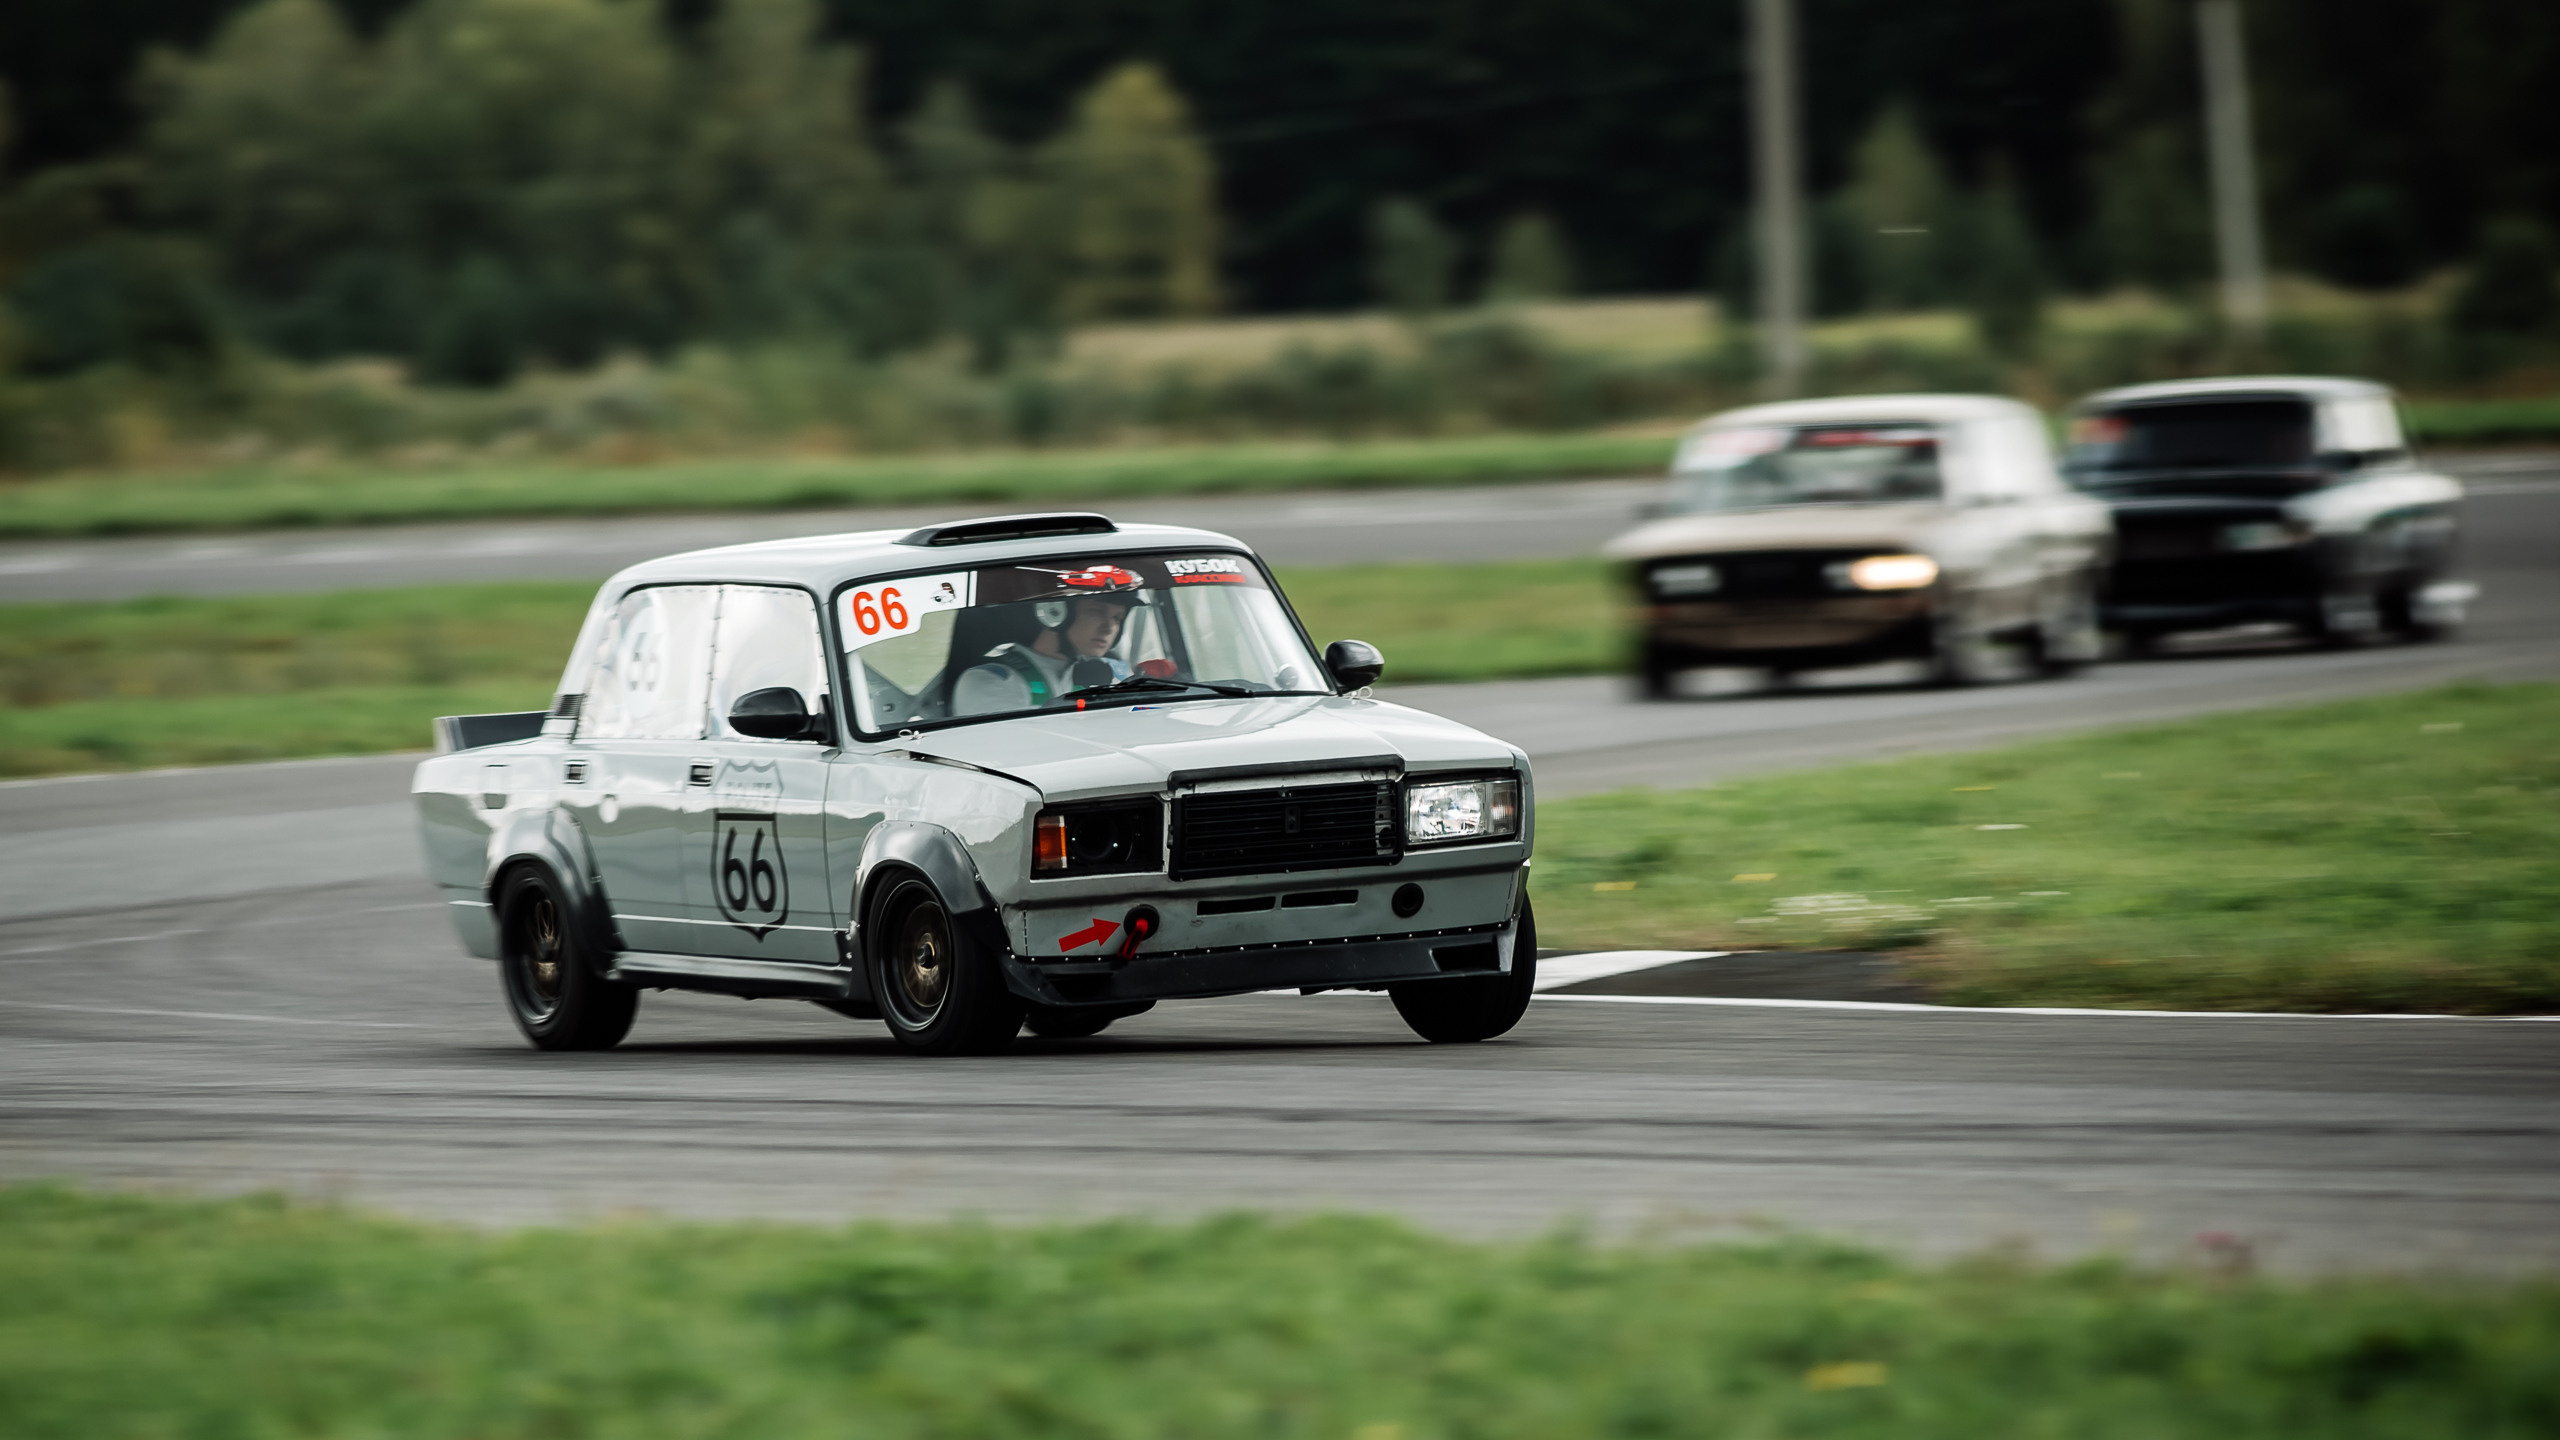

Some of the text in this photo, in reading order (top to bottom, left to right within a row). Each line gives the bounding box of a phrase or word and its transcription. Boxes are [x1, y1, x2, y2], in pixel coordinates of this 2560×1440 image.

[1164, 559, 1241, 573] КУБОК
[853, 587, 908, 635] 66
[724, 827, 777, 912] 66
